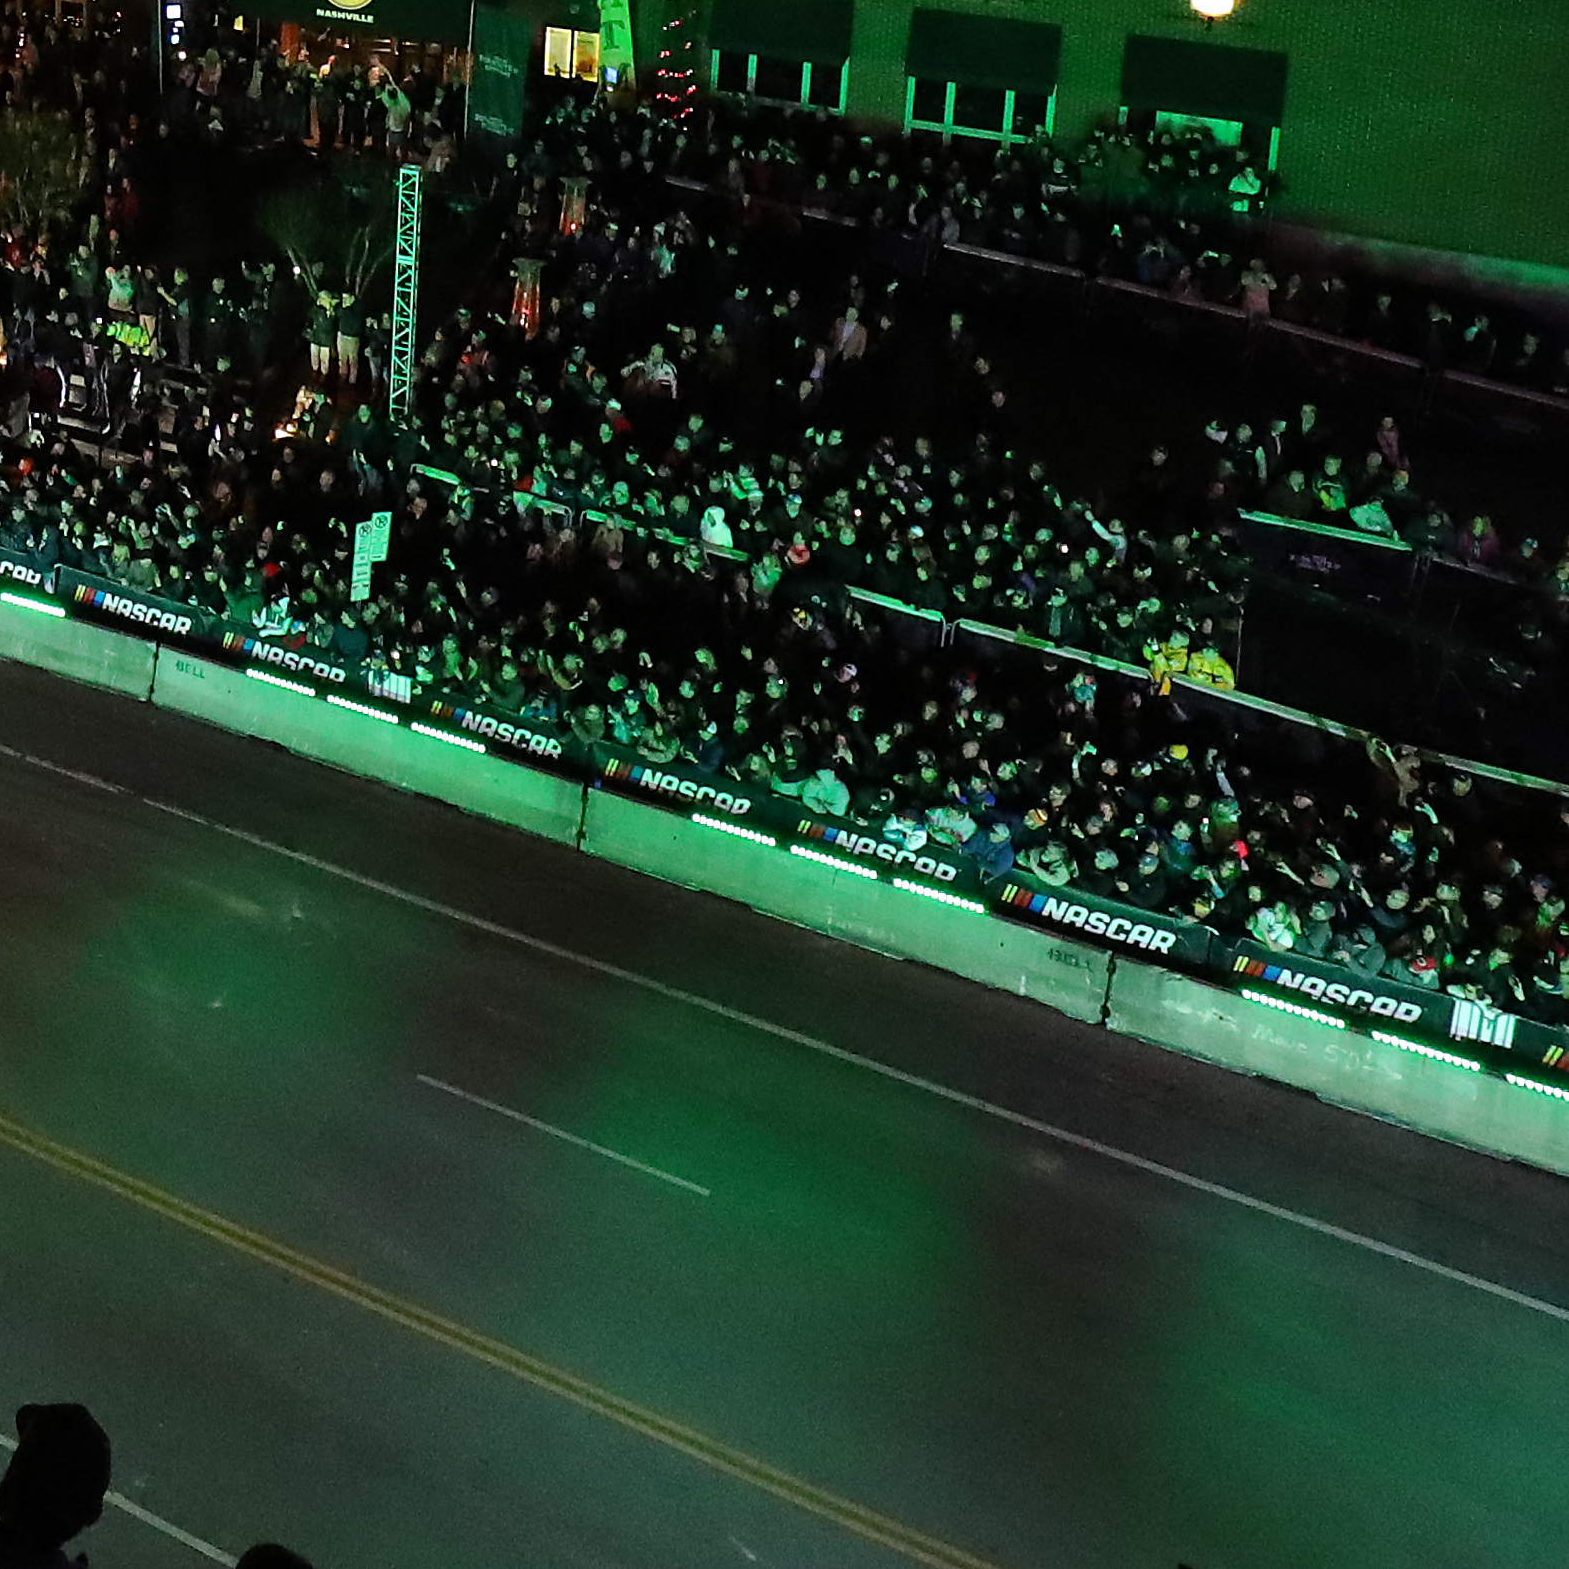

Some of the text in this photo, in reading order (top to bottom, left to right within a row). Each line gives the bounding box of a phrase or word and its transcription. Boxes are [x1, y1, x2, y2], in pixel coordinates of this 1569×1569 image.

[316, 8, 374, 24] NASHVILLE
[101, 592, 193, 636] NASCAR
[461, 710, 563, 760] NASCAR
[1041, 896, 1178, 955] NASCAR
